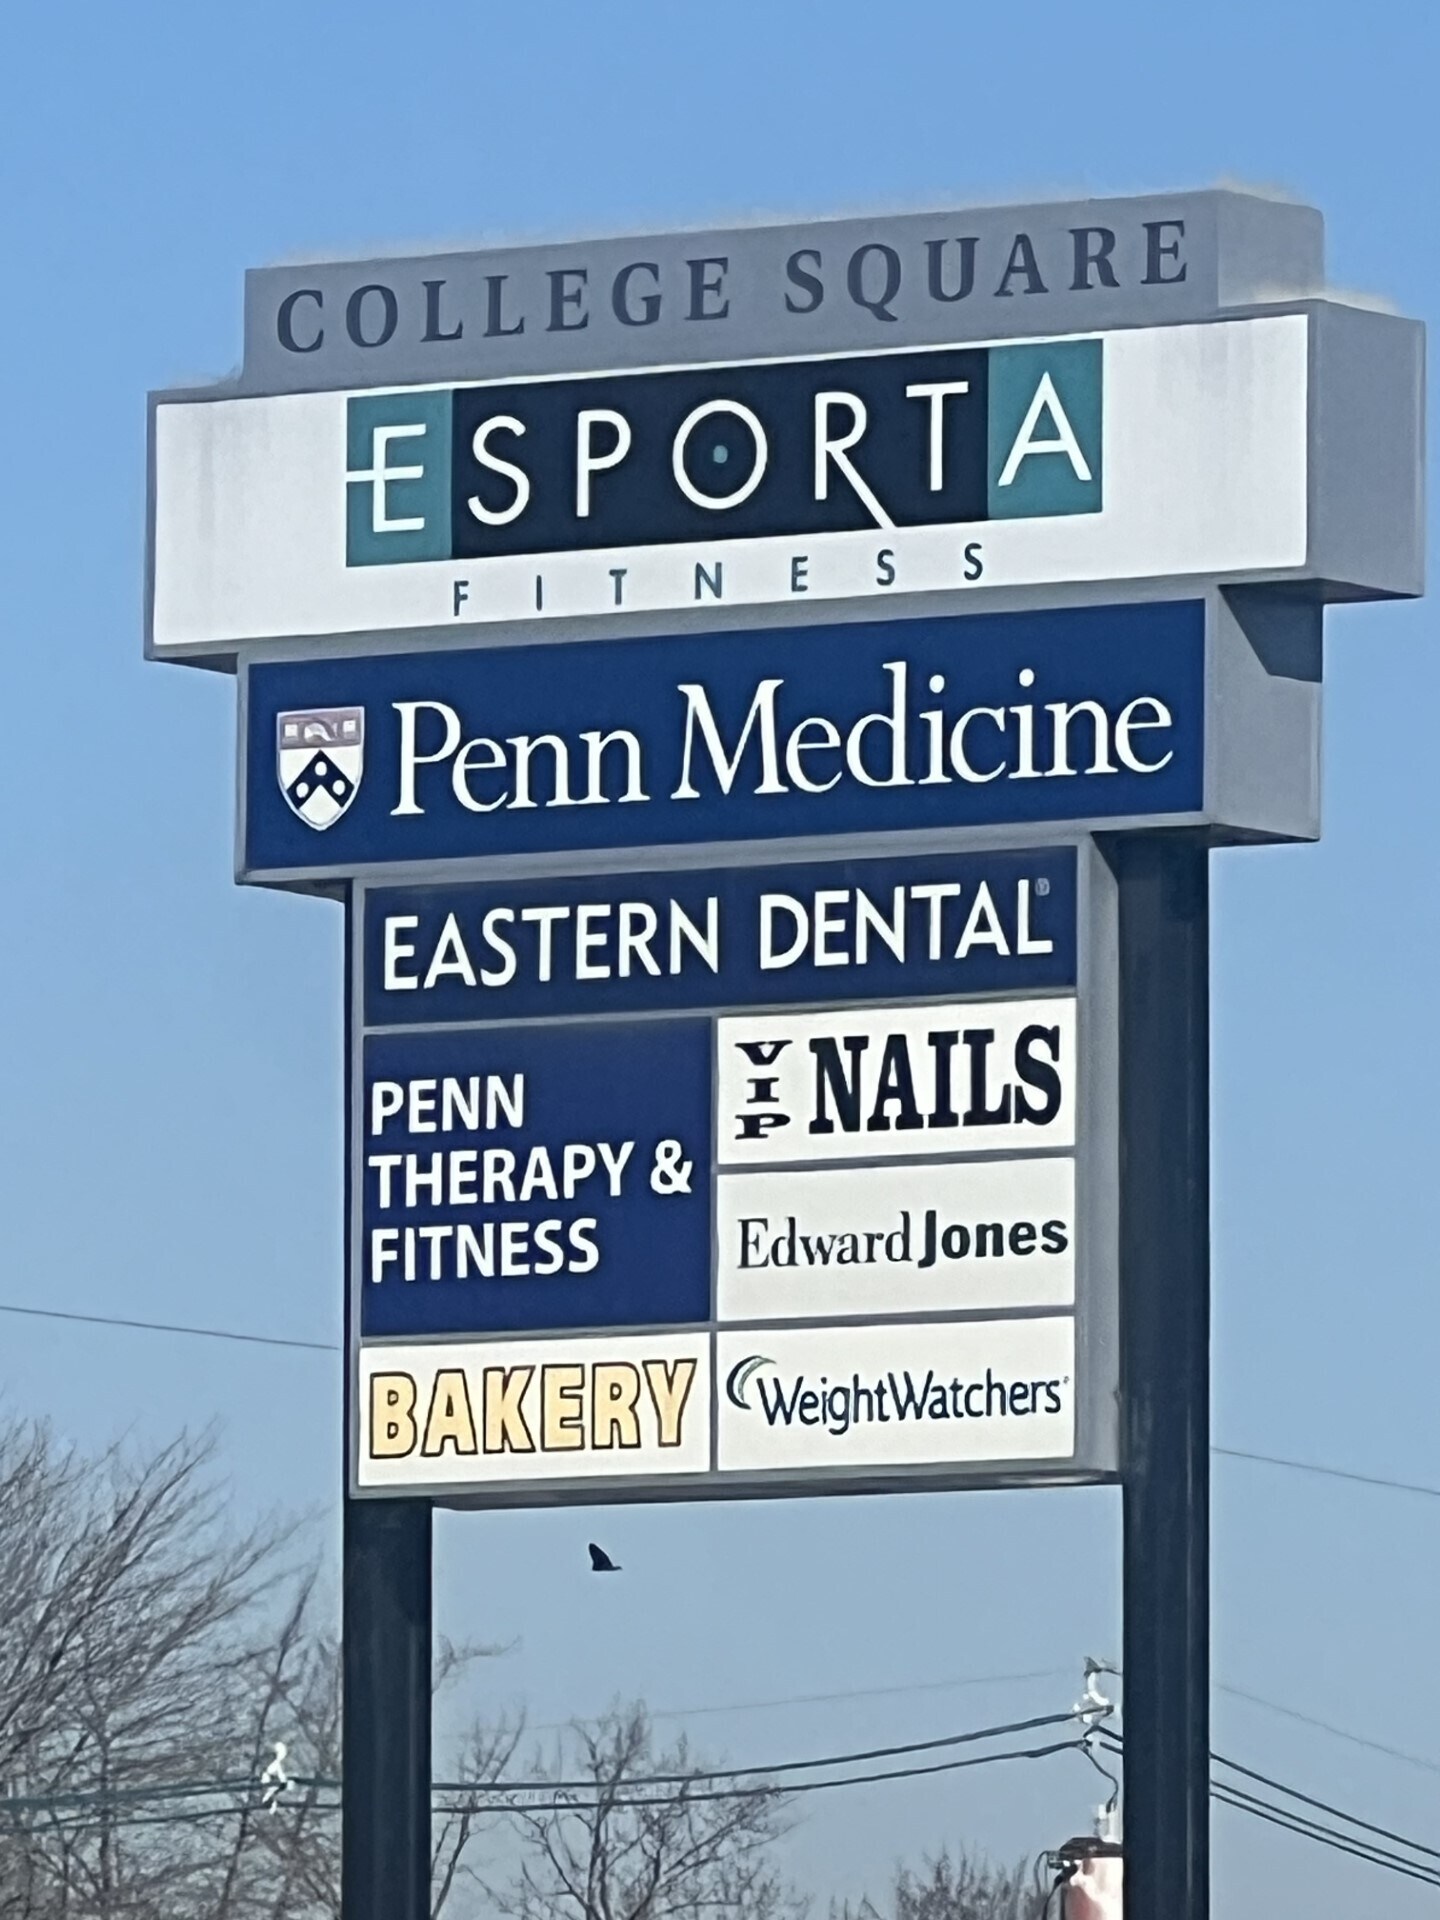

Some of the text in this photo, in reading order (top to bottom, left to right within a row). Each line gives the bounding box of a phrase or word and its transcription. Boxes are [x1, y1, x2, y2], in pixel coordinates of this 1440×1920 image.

[276, 220, 1189, 353] COLLEGE SQUARE
[346, 371, 1093, 532] ESPORTA
[453, 543, 983, 616] FITNESS
[390, 661, 1174, 816] Penn Medicine
[384, 879, 1053, 990] EASTERN DENTAL
[371, 1073, 525, 1136] PENN
[734, 1039, 793, 1140] VIP
[808, 1024, 1062, 1134] NAILS
[368, 1139, 693, 1208] THERAPY &
[371, 1217, 600, 1283] FITNESS
[369, 1358, 698, 1459] BAKERY
